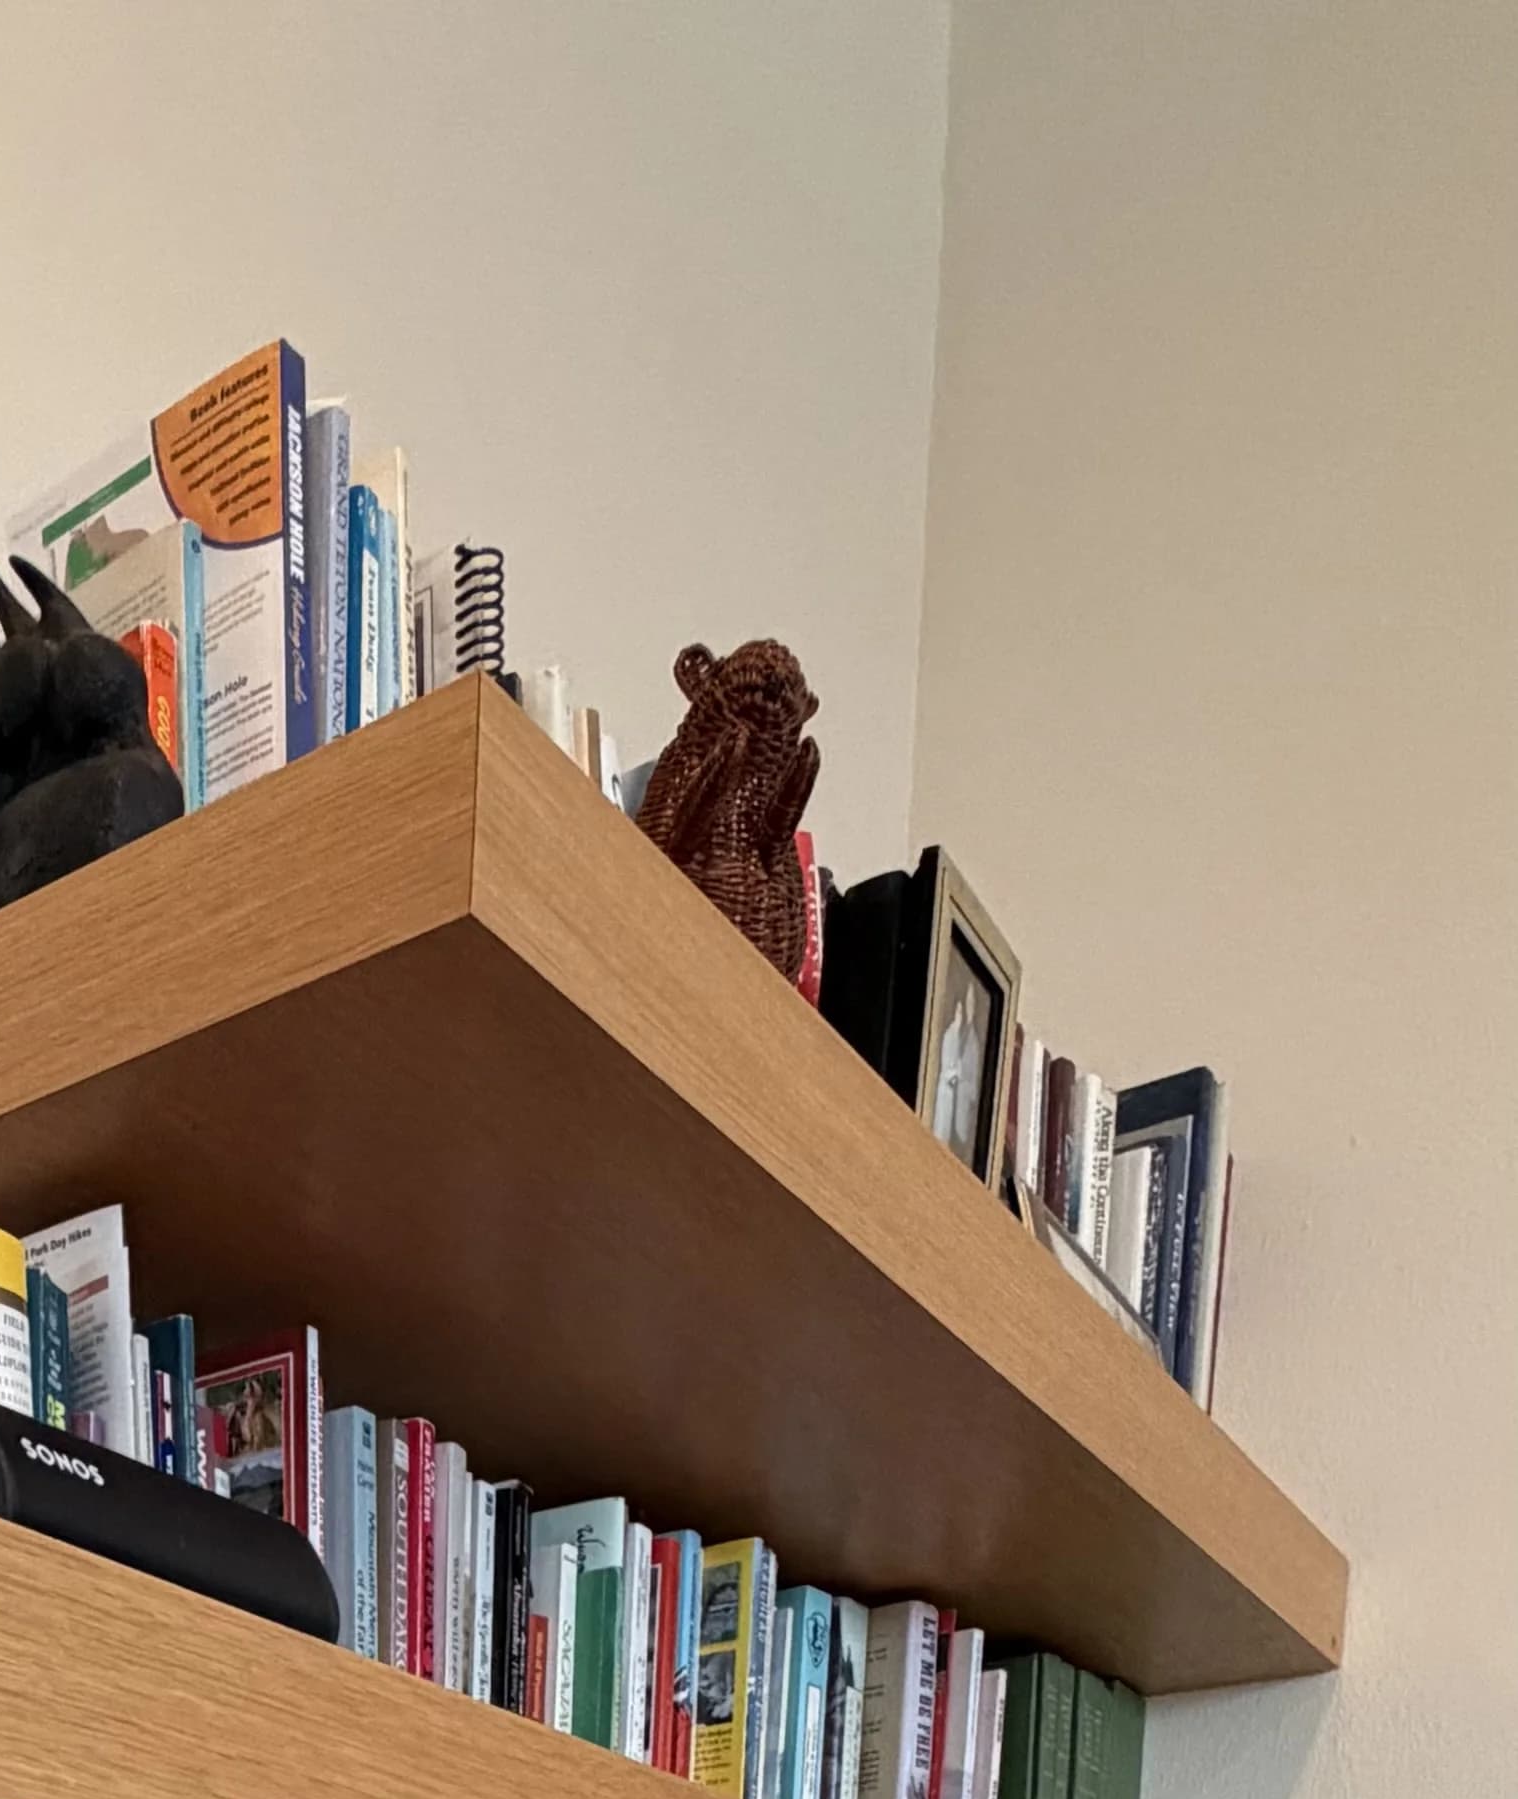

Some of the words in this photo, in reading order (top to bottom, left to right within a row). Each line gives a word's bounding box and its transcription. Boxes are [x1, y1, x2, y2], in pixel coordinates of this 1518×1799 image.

[220, 364, 268, 402] features
[288, 404, 303, 519] JACKSON
[336, 434, 348, 529] GRAND
[289, 517, 305, 584] HOLE
[333, 537, 347, 620] TETON
[1098, 1106, 1113, 1151] Along
[1097, 1157, 1110, 1183] the
[50, 1237, 66, 1251] Day
[68, 1227, 92, 1244] Hikes
[3, 1314, 24, 1331] FIELD
[20, 1437, 105, 1486] SONOS
[366, 1512, 377, 1601] Mountain
[394, 1475, 409, 1593] SOUTH
[355, 1593, 365, 1623] the
[922, 1615, 936, 1656] LET
[919, 1658, 935, 1692] ME
[918, 1693, 933, 1719] BE
[914, 1722, 931, 1770] FREE
